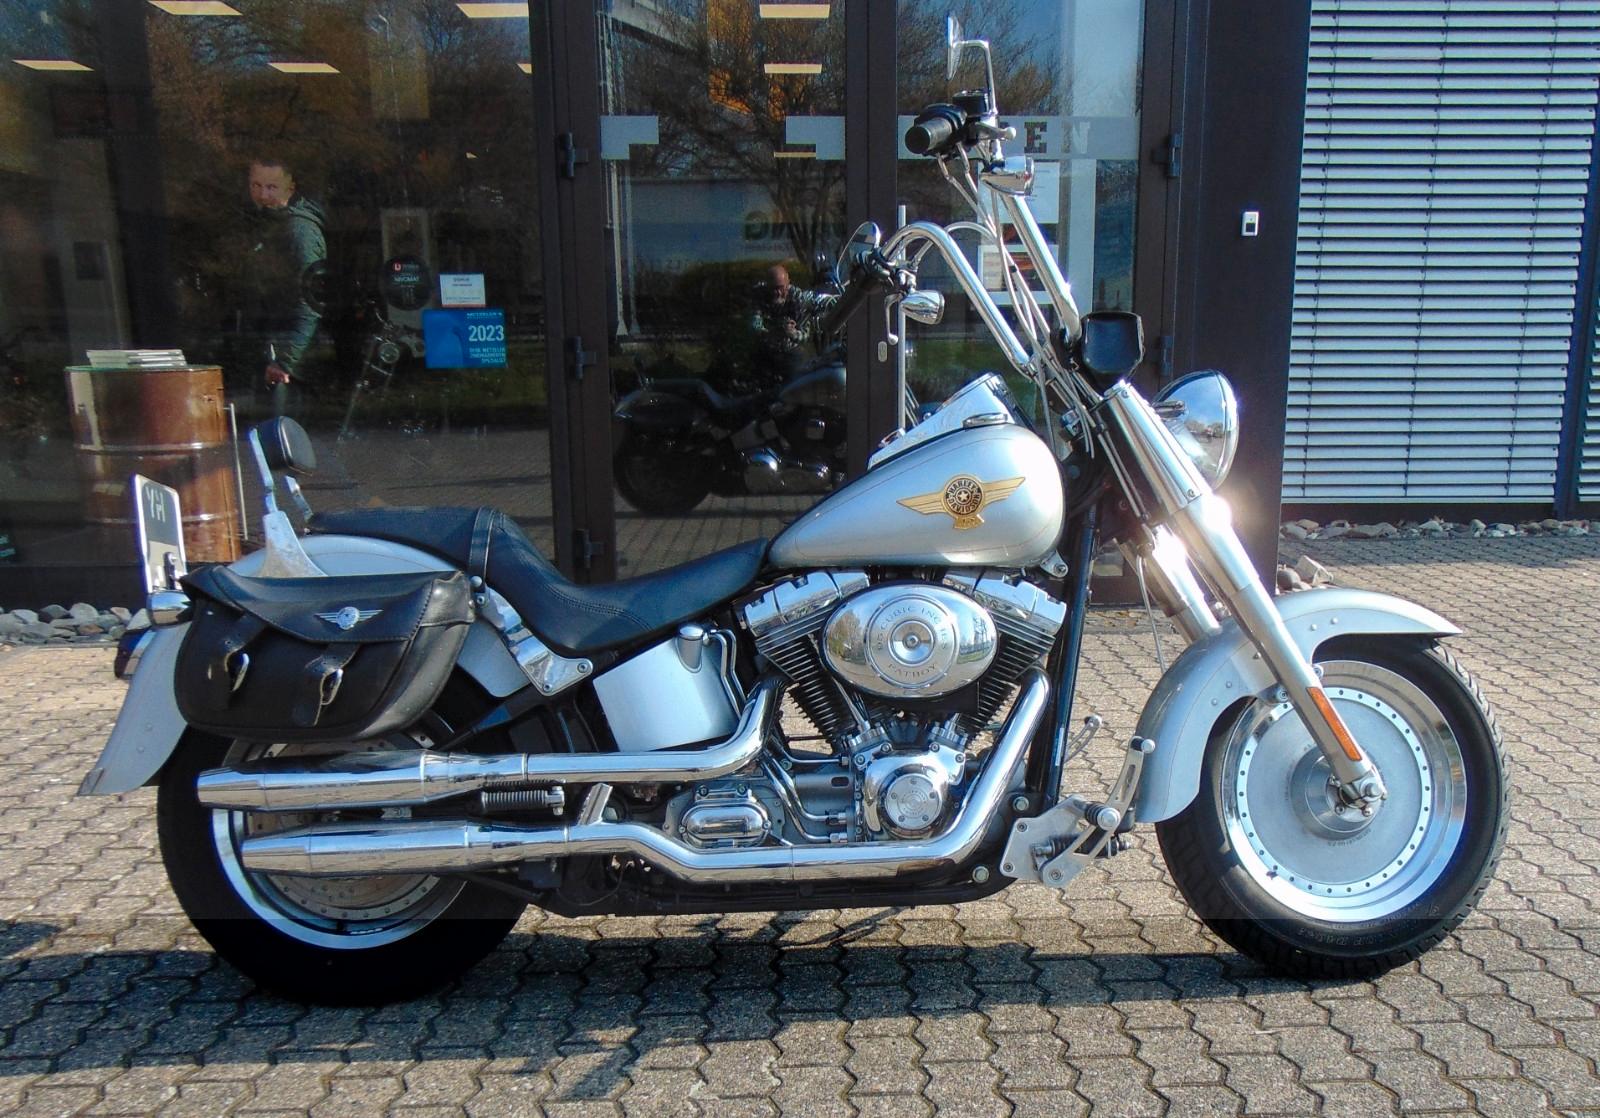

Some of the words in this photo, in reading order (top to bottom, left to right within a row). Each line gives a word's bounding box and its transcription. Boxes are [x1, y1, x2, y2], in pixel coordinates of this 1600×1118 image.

[468, 325, 505, 341] 2023
[948, 480, 976, 494] HARLEY
[947, 493, 981, 513] DAVIDSON
[880, 606, 917, 631] CUBIC
